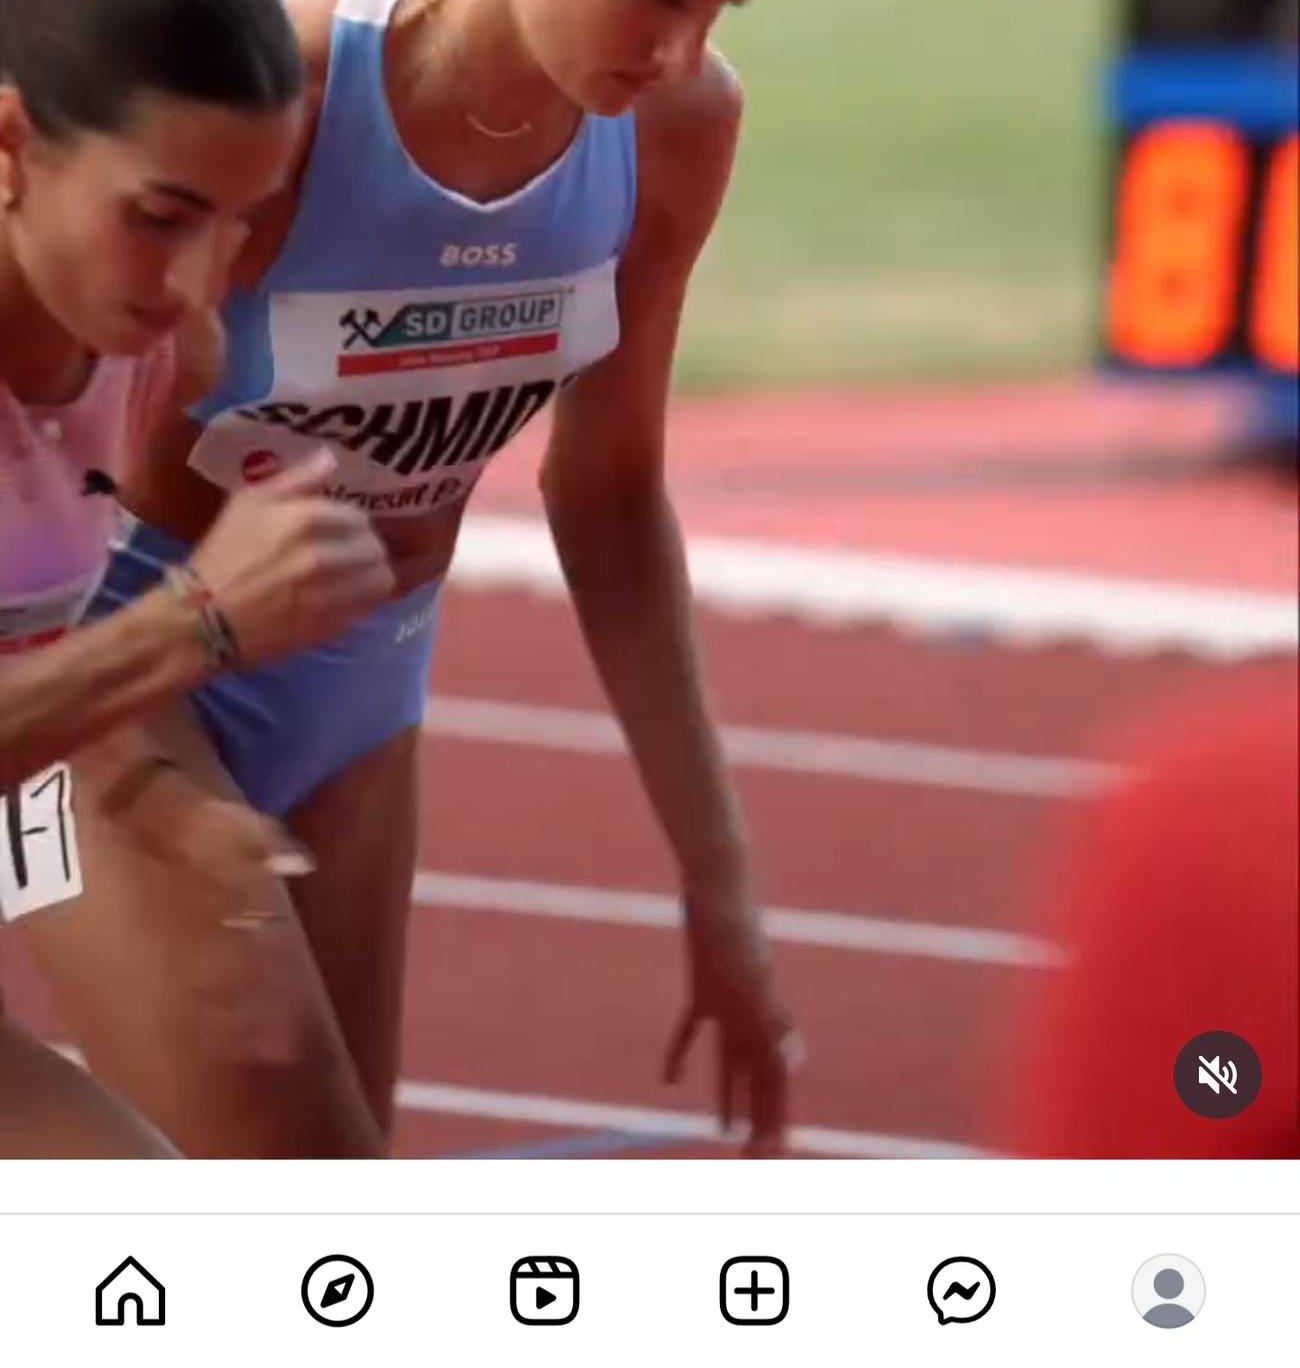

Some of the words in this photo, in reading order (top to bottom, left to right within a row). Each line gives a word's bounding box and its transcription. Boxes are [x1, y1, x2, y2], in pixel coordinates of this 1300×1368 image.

[439, 243, 518, 267] BOSS
[404, 311, 449, 338] SD
[458, 297, 555, 332] GROUP
[236, 374, 578, 476] SCHMID
